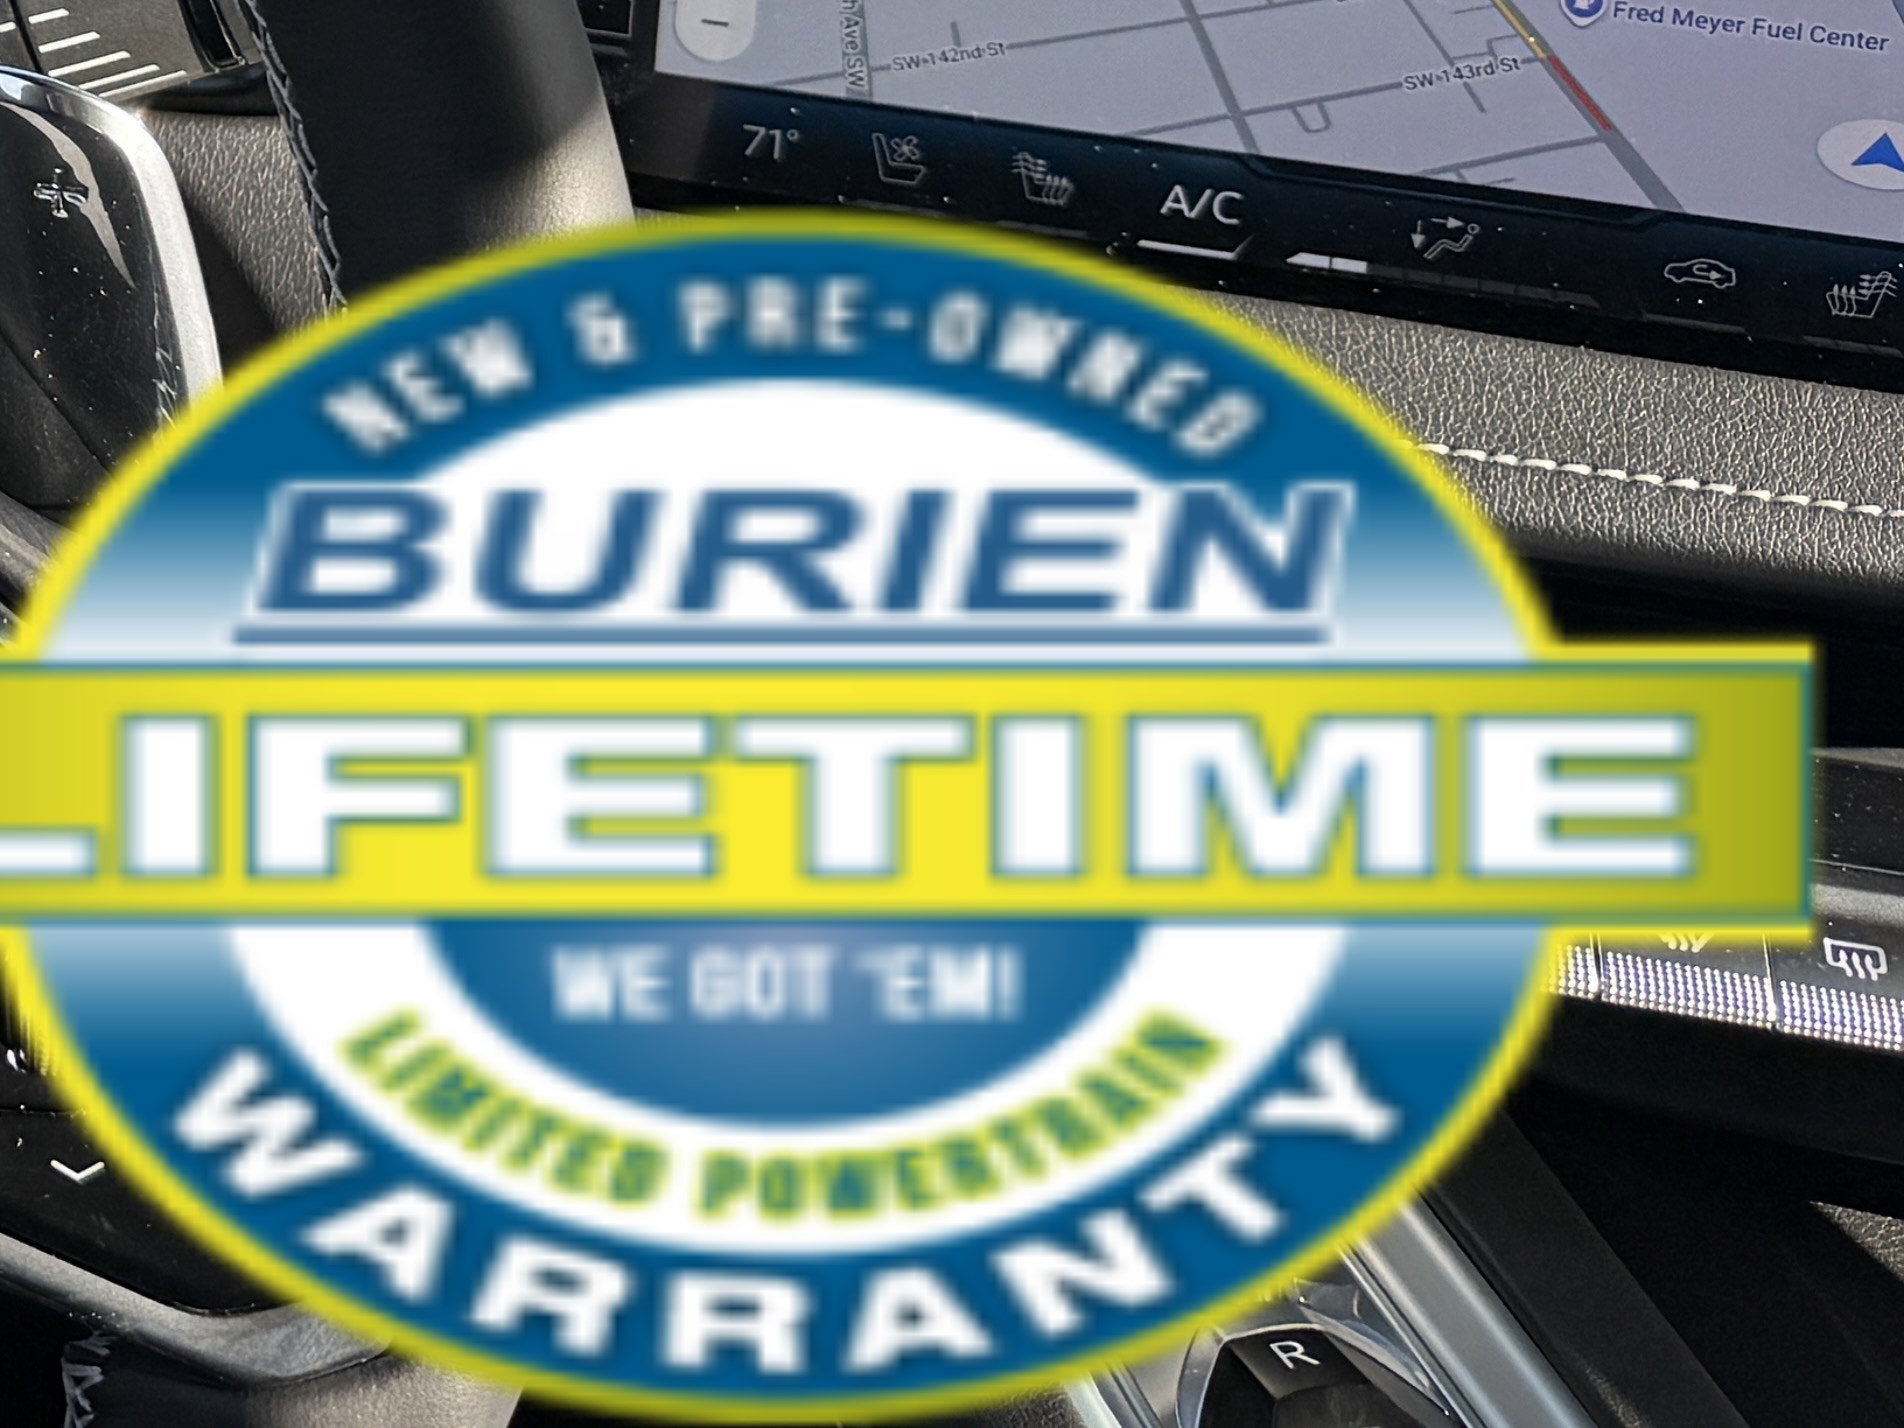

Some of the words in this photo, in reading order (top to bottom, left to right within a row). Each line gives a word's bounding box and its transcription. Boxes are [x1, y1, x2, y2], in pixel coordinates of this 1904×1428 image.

[844, 14, 860, 51] Ave
[1613, 0, 1664, 23] Fred
[1673, 8, 1745, 34] Meyer
[1752, 18, 1802, 40] Fuel
[1810, 26, 1890, 51] Center
[846, 56, 865, 88] SW
[893, 56, 921, 71] SW
[928, 47, 981, 66] 142nd
[987, 43, 1007, 56] St
[1403, 74, 1433, 90] SW
[1442, 61, 1495, 83] 143rd
[1499, 58, 1520, 72] St
[743, 123, 800, 161] 71°
[1161, 184, 1245, 225] A/C
[1270, 1341, 1320, 1370] R
